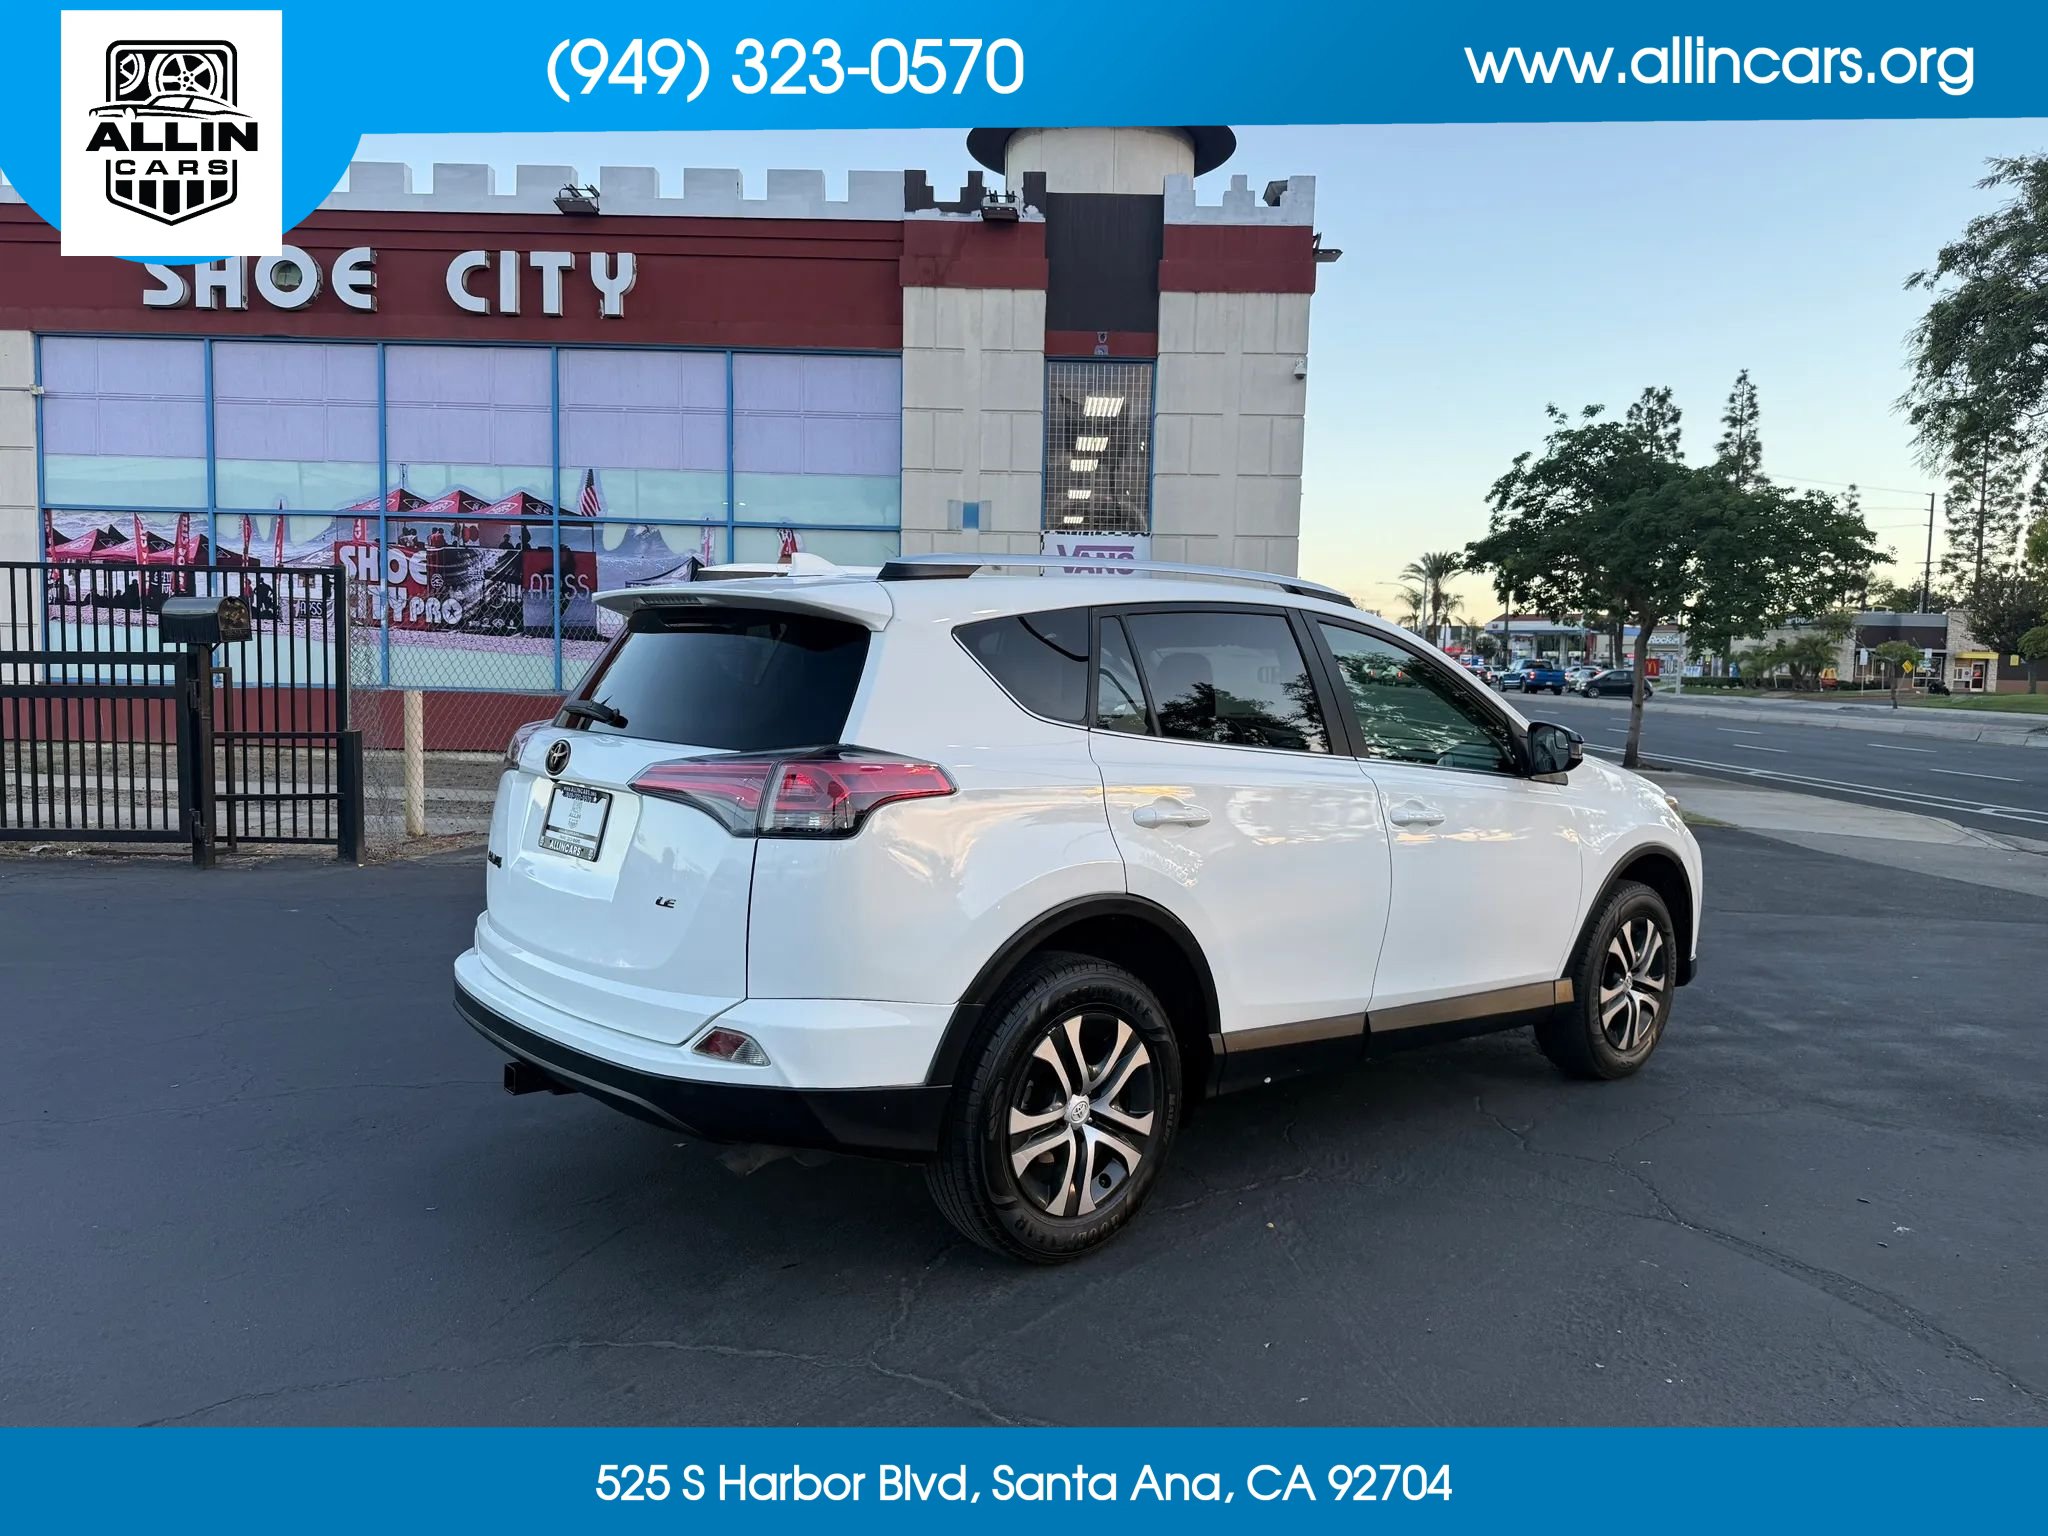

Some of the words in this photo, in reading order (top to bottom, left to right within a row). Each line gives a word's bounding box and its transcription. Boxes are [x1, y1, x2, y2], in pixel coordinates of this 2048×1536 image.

[143, 244, 377, 310] SHOE
[446, 250, 637, 318] CITY
[340, 545, 428, 585] SHOE
[409, 596, 463, 625] PRO
[655, 896, 676, 909] LE
